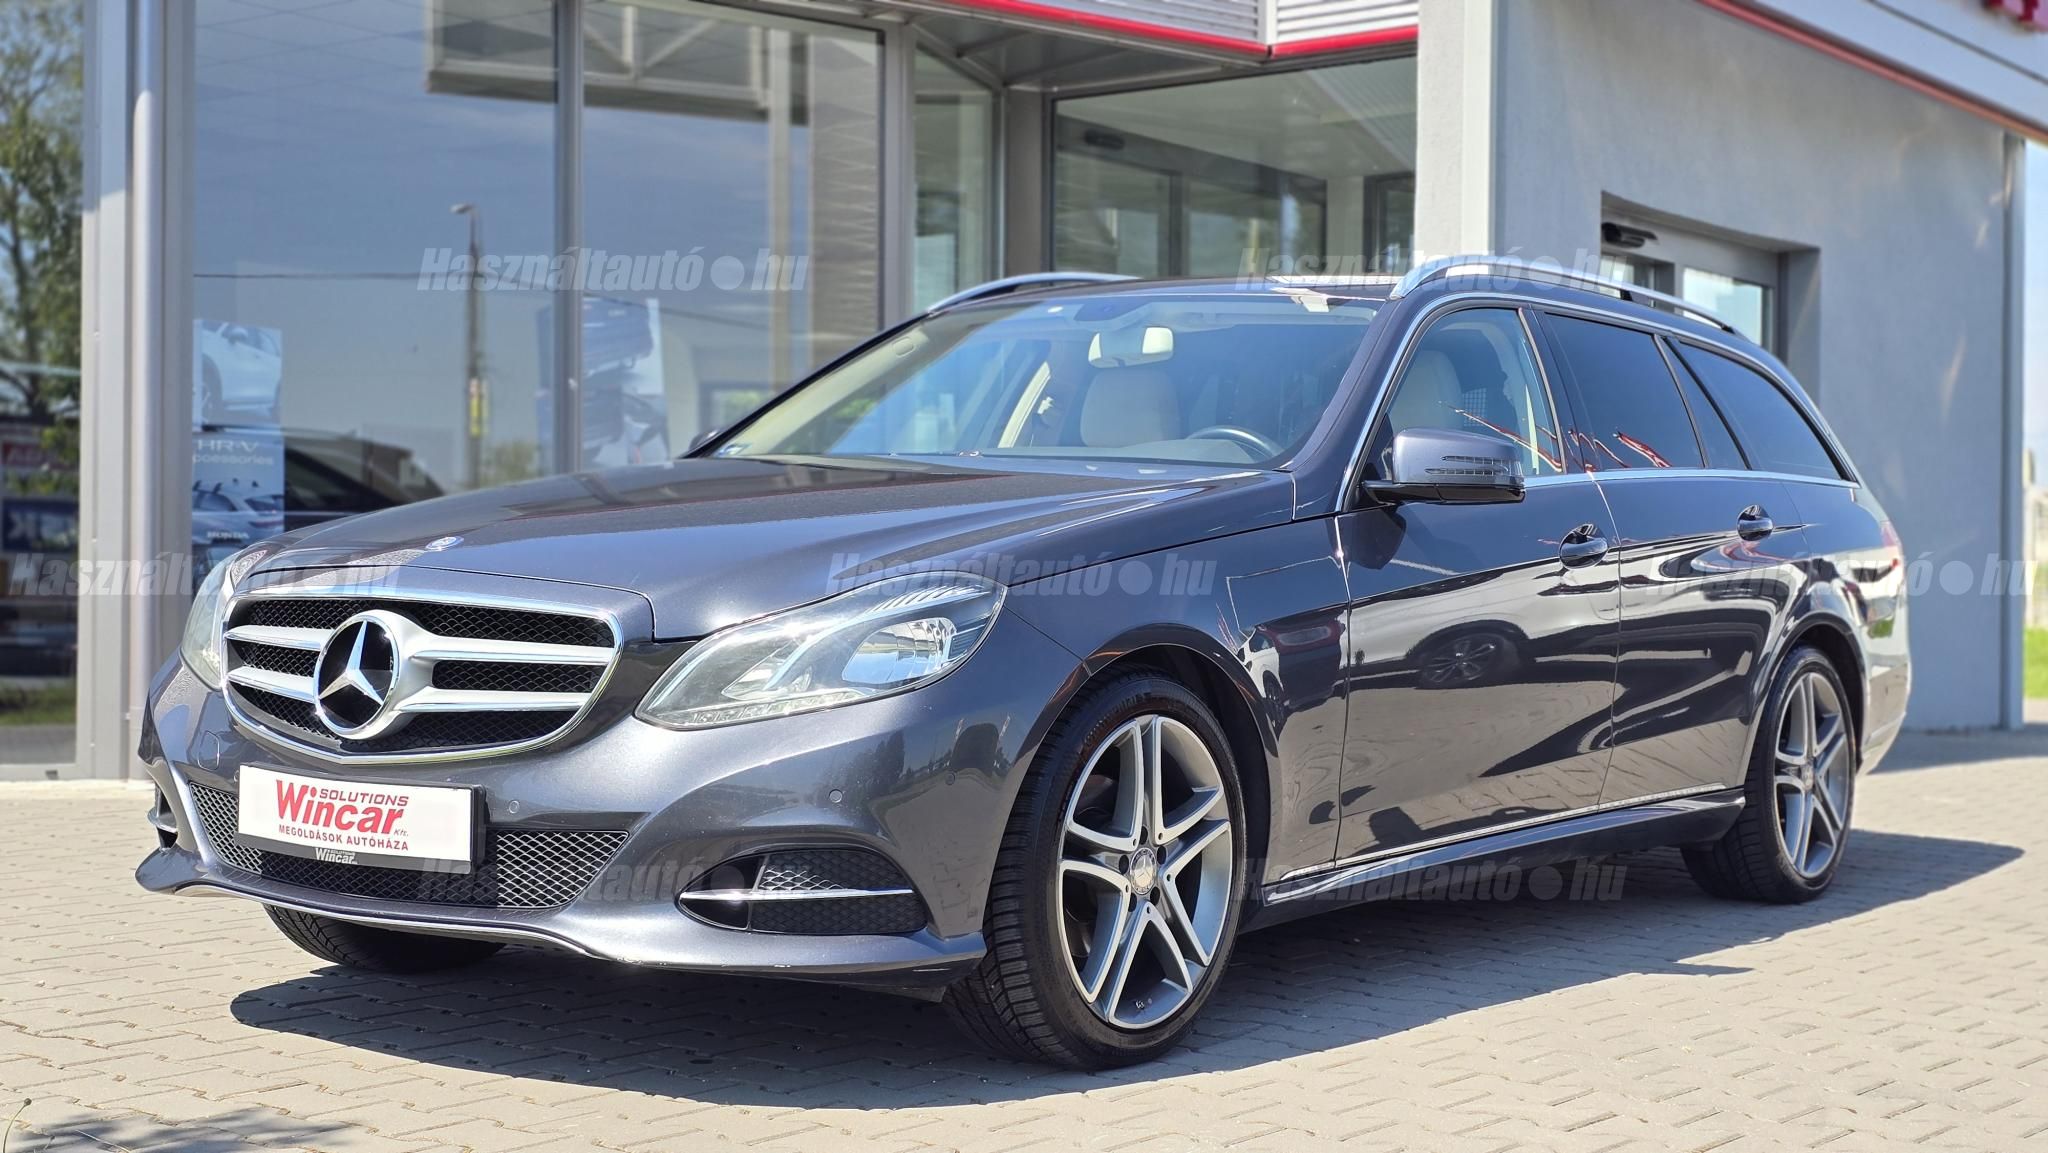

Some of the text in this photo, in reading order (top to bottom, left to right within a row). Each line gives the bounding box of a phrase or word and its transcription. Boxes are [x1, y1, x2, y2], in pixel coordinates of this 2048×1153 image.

[275, 778, 404, 835] Wincar
[319, 788, 410, 807] SOLUTIONS
[278, 824, 410, 852] MEGOLDÁSOK AUTÓHÁZA
[315, 847, 355, 865] Wincar
